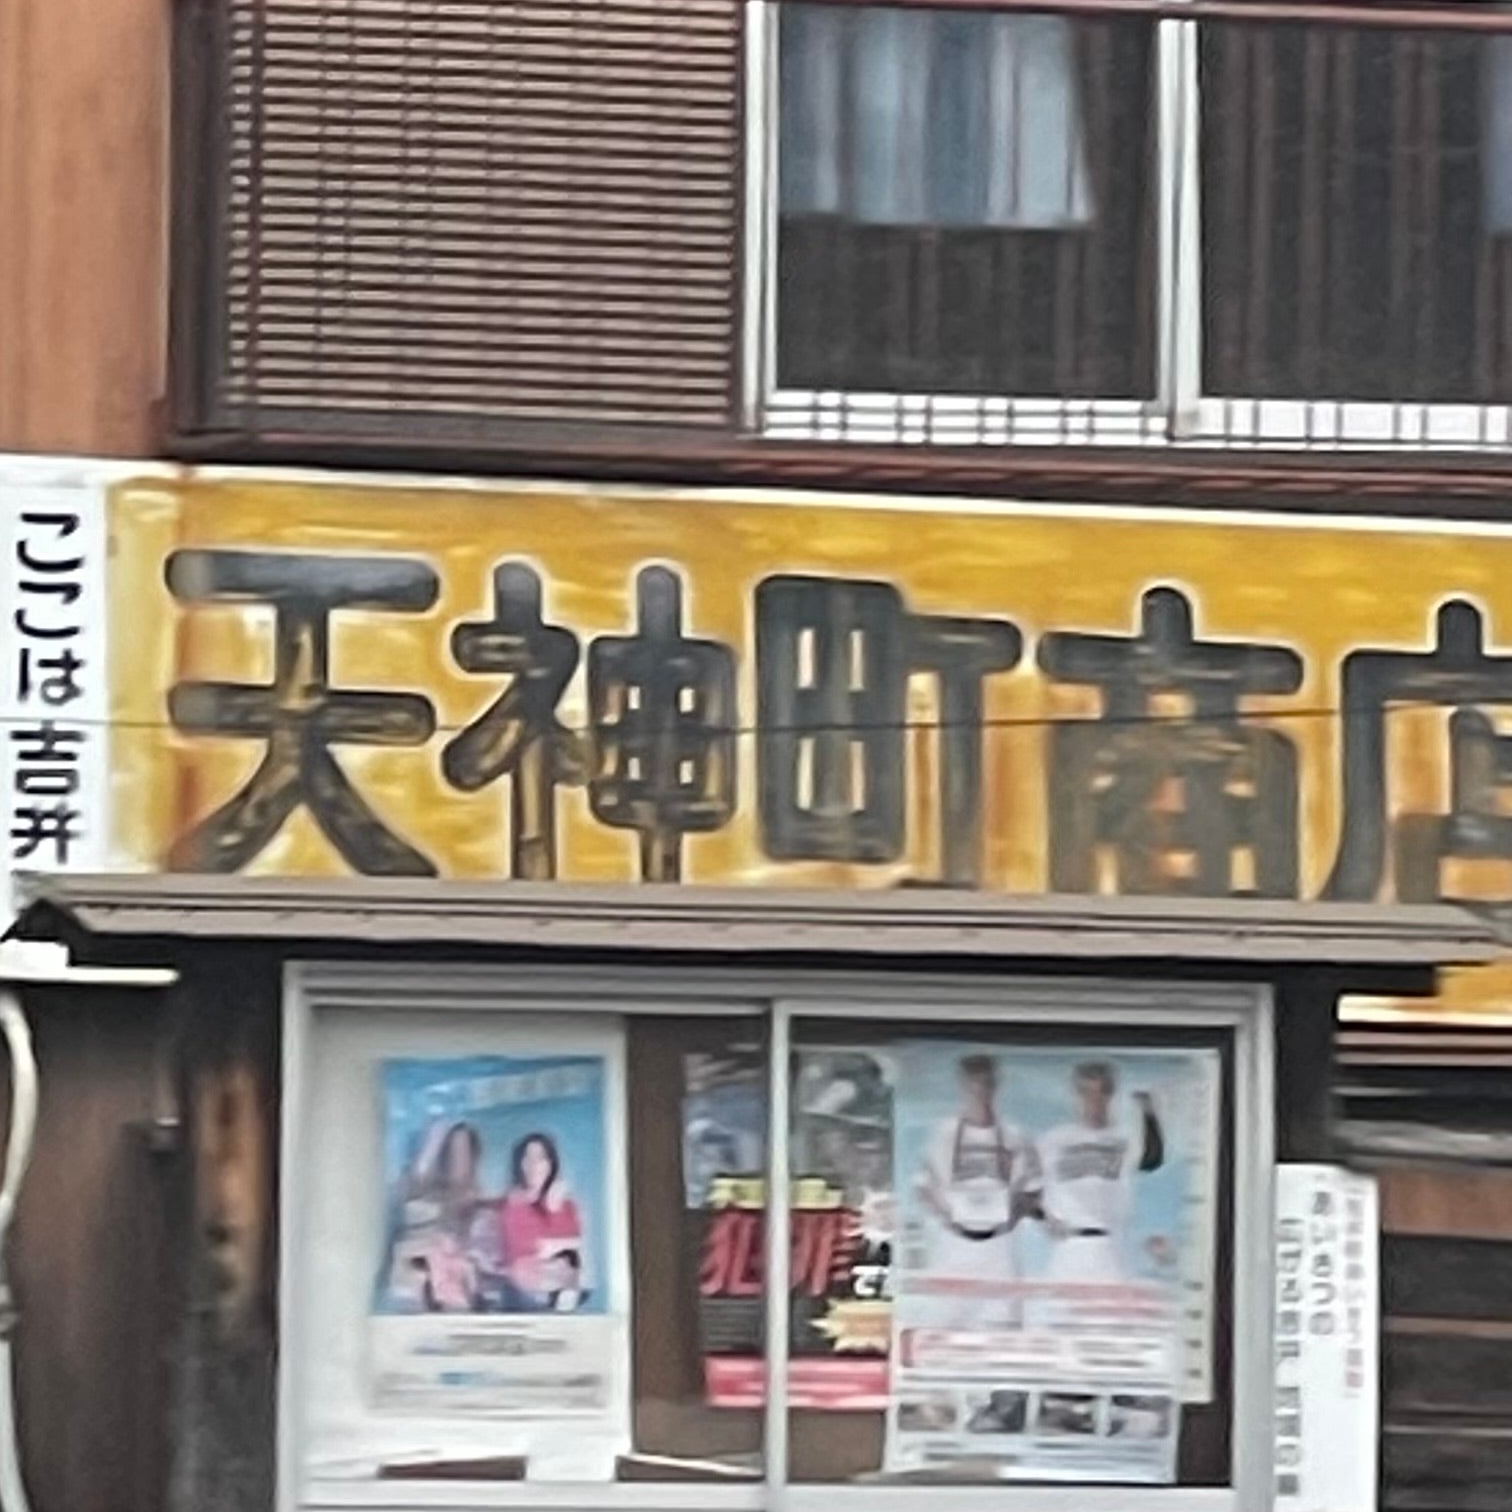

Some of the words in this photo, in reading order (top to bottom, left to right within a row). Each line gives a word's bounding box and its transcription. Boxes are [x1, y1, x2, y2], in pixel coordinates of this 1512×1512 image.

[9, 512, 87, 864] ここは吉井
